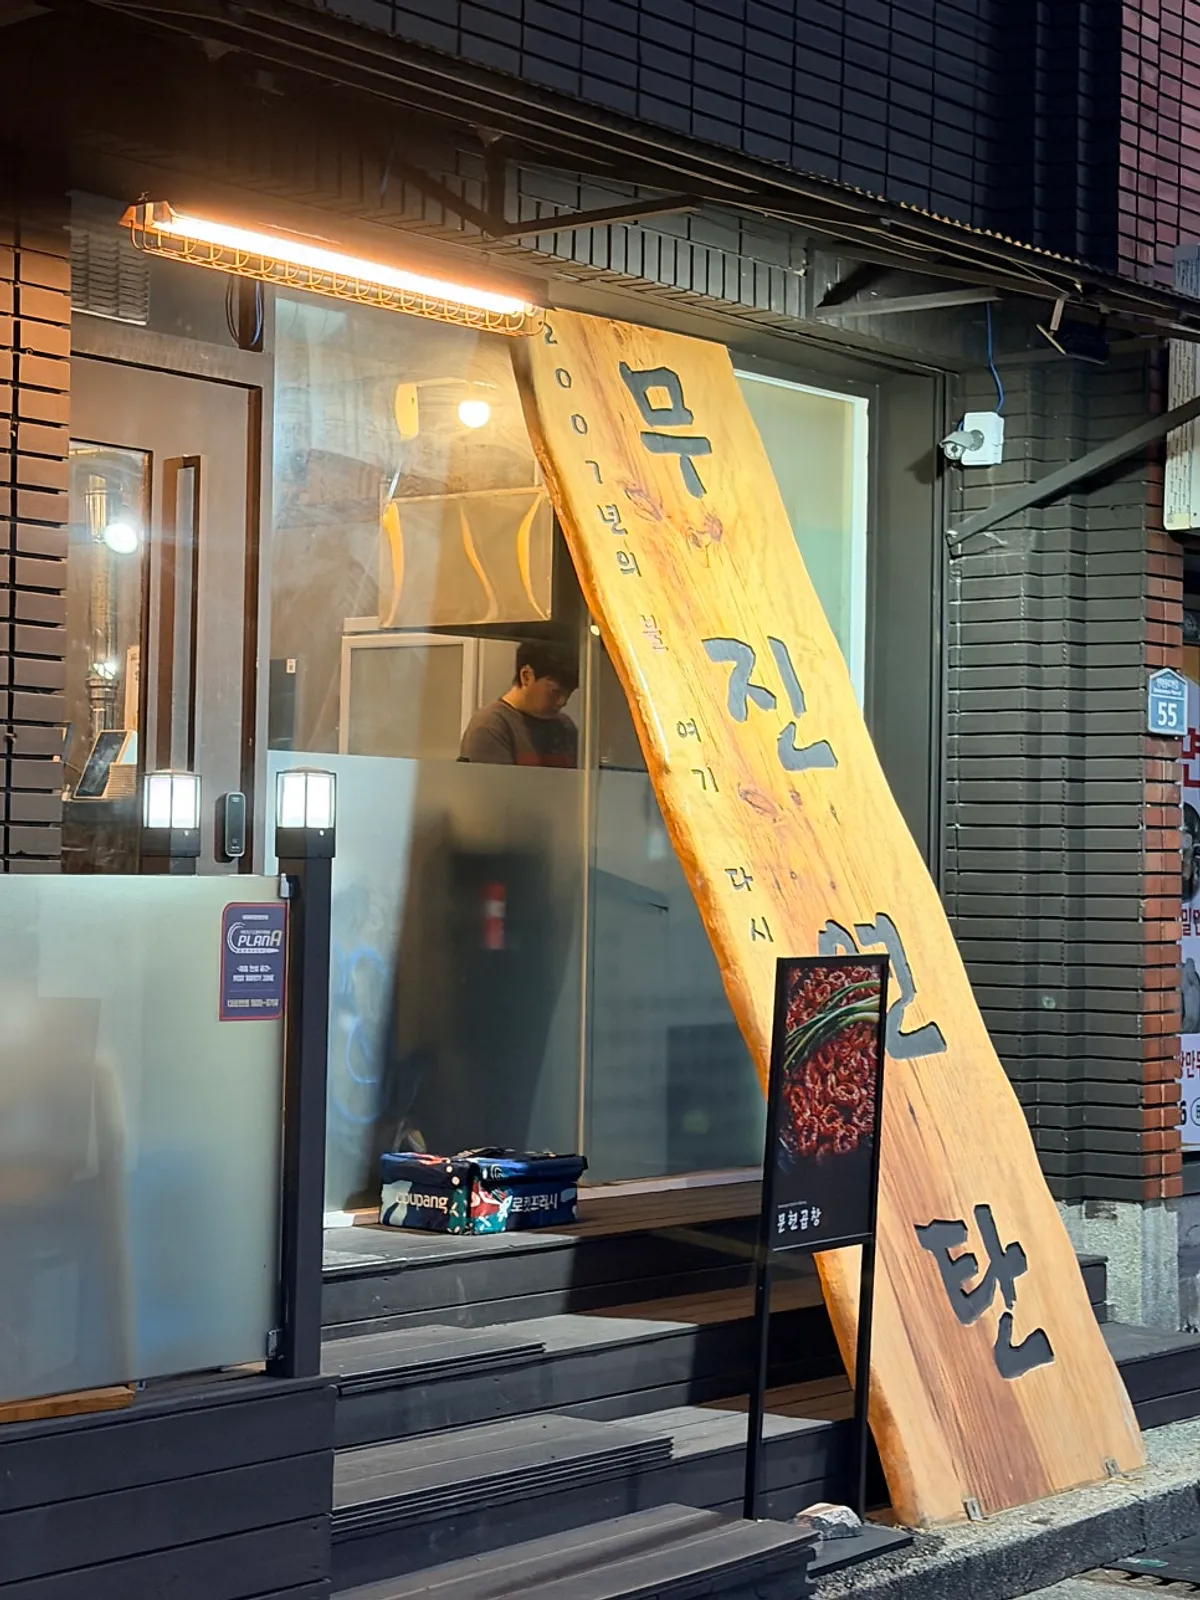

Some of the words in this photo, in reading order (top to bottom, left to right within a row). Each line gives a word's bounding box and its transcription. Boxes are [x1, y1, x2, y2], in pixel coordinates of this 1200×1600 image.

[1157, 701, 1178, 727] 55
[676, 718, 719, 793] 여기
[725, 867, 774, 942] 다시
[396, 1192, 448, 1214] coupang
